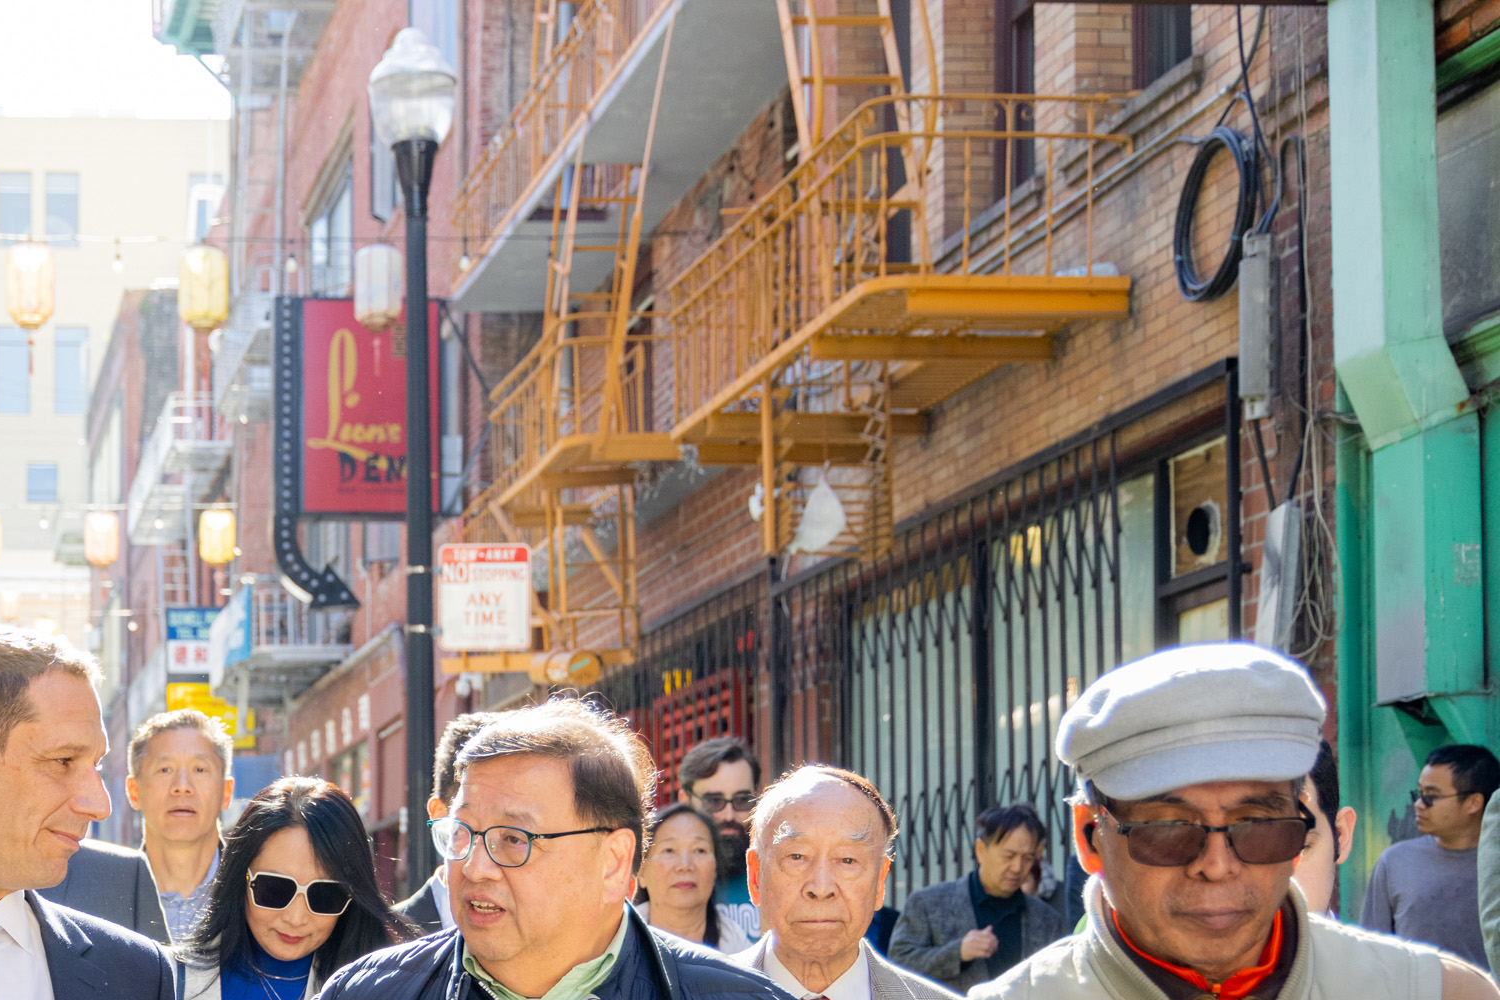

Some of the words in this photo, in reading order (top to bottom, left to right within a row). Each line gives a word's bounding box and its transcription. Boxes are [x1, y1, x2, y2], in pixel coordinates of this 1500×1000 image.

[453, 549, 516, 561] TOW-AWAY
[443, 563, 468, 583] NO
[472, 567, 525, 582] STOPPING
[466, 592, 503, 606] ANY
[463, 611, 507, 626] TIME
